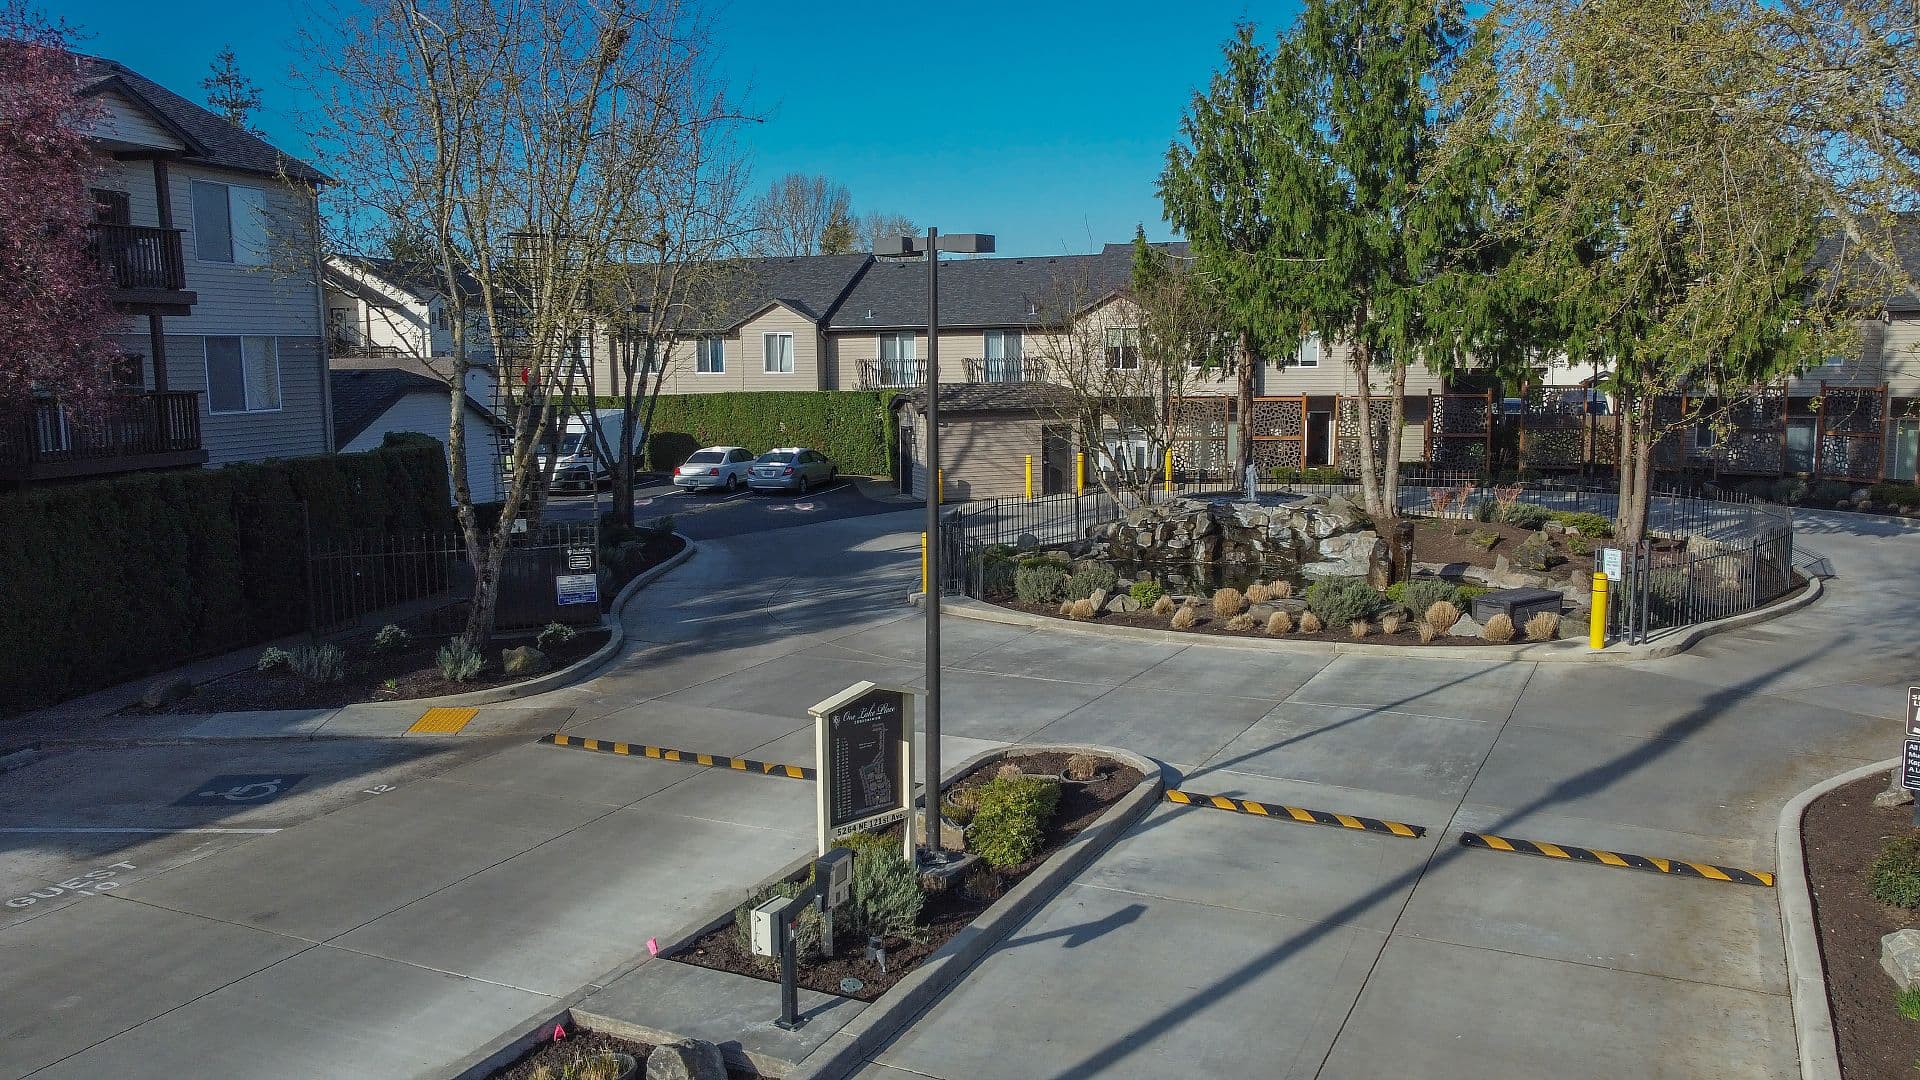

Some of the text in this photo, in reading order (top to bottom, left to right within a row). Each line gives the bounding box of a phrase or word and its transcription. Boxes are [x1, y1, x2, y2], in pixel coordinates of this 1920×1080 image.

[842, 711, 856, 721] One
[857, 702, 876, 719] Lake
[876, 703, 896, 715] Place
[362, 784, 397, 795] 12
[837, 825, 857, 836] 5264
[858, 821, 868, 831] NE
[869, 815, 889, 828] 121st
[5, 860, 137, 908] GUEST
